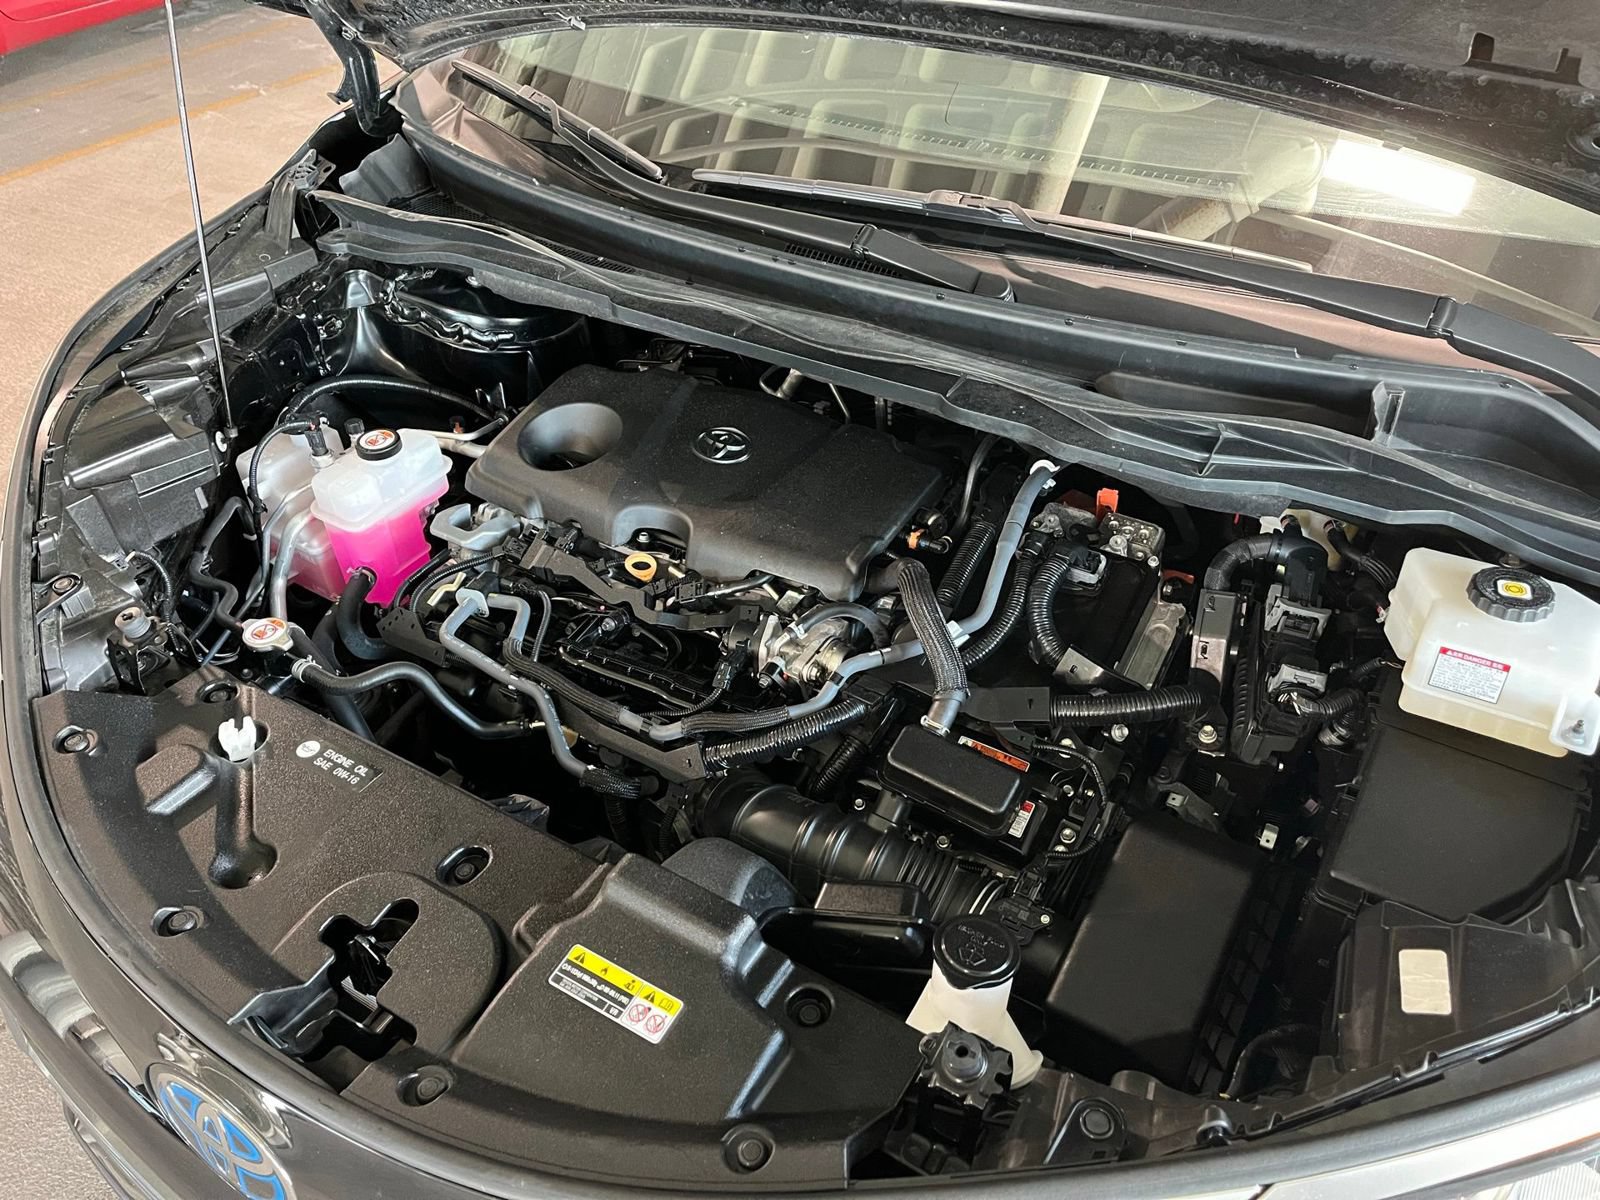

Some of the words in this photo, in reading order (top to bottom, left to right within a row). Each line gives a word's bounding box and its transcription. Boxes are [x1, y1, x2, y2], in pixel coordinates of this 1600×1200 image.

[1463, 654, 1492, 667] DANGER
[313, 757, 334, 771] SAE
[332, 767, 360, 785] 0W-16
[323, 749, 355, 768] ENGINE
[354, 765, 369, 777] OIL
